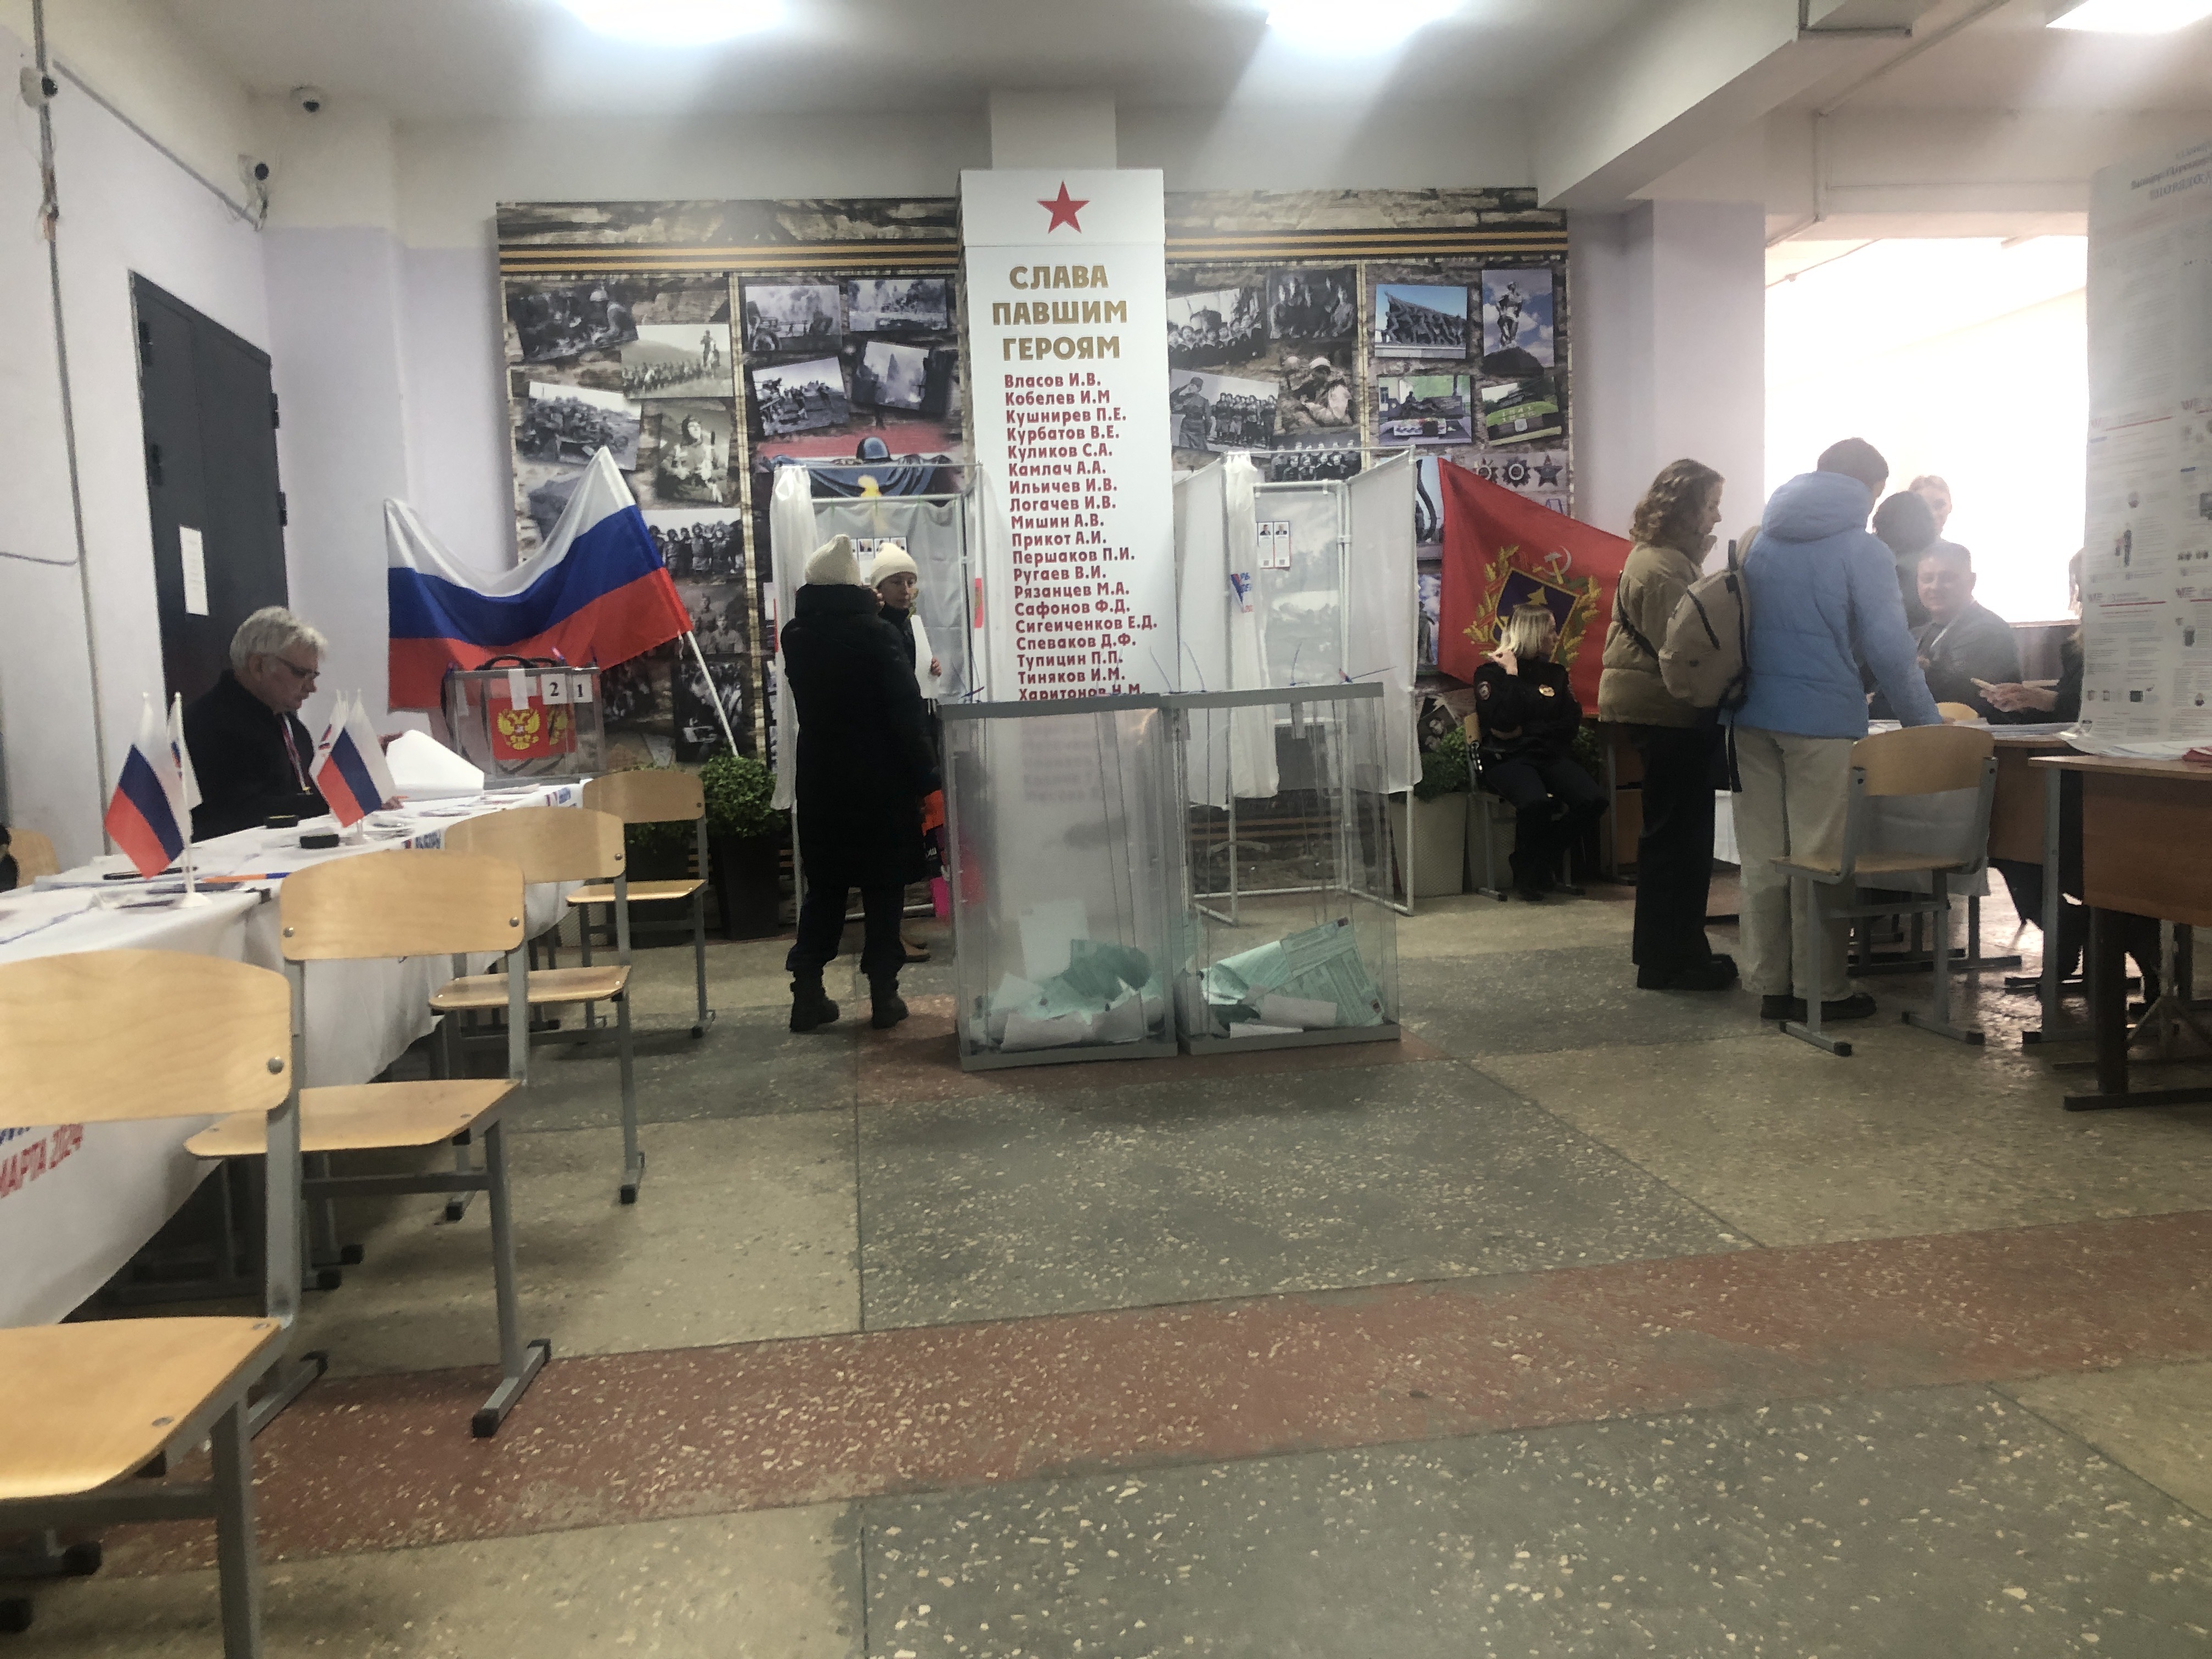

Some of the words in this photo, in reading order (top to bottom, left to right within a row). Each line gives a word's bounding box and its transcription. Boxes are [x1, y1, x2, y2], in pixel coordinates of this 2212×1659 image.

[1009, 265, 1109, 290] СЛАВА
[992, 300, 1127, 326] ПАВШИМ
[1003, 336, 1120, 361] ГЕРОЯМ
[1005, 375, 1063, 388] Власов
[1069, 373, 1101, 386] И.В.
[1006, 391, 1075, 406] Кобелев
[1080, 390, 1110, 404] И.М
[1006, 409, 1091, 427] Кушнирев
[1096, 407, 1126, 421] П.Е.
[1007, 426, 1085, 445] Курбатов
[1091, 425, 1119, 439] В.Е.
[1008, 445, 1077, 463] Куликов
[1082, 443, 1113, 457] С.А.
[1009, 463, 1072, 477] Камлач
[1077, 461, 1106, 475] А.А.
[1009, 480, 1080, 494] Ильичев
[1086, 478, 1117, 492] И.В.
[1009, 498, 1079, 512] Логачев
[1085, 495, 1116, 510] И.В.
[1011, 516, 1069, 529] Мишин
[1074, 514, 1104, 527] А.В.
[1012, 533, 1070, 551] Прикот
[1076, 531, 1107, 545] А.И.
[1013, 550, 1097, 567] Першаков
[1103, 547, 1135, 561] П.И.
[1014, 568, 1070, 585] Ругаев
[1075, 565, 1106, 579] В.И.
[1014, 585, 1092, 599] Рязанцев
[1097, 582, 1130, 595] М.А.
[1014, 601, 1090, 619] Сафонов
[1095, 599, 1130, 614] Ф.Д.
[1128, 615, 1158, 630] Е.Д.
[1016, 637, 1096, 651] Спеваков
[1101, 633, 1137, 649] Д.Ф.
[1017, 654, 1086, 672] Тупицин
[1091, 651, 1124, 664] П.П.
[1018, 672, 1086, 685] Тиняков
[1091, 668, 1125, 681] И.М.
[549, 682, 560, 697] 2
[577, 684, 583, 698] 1
